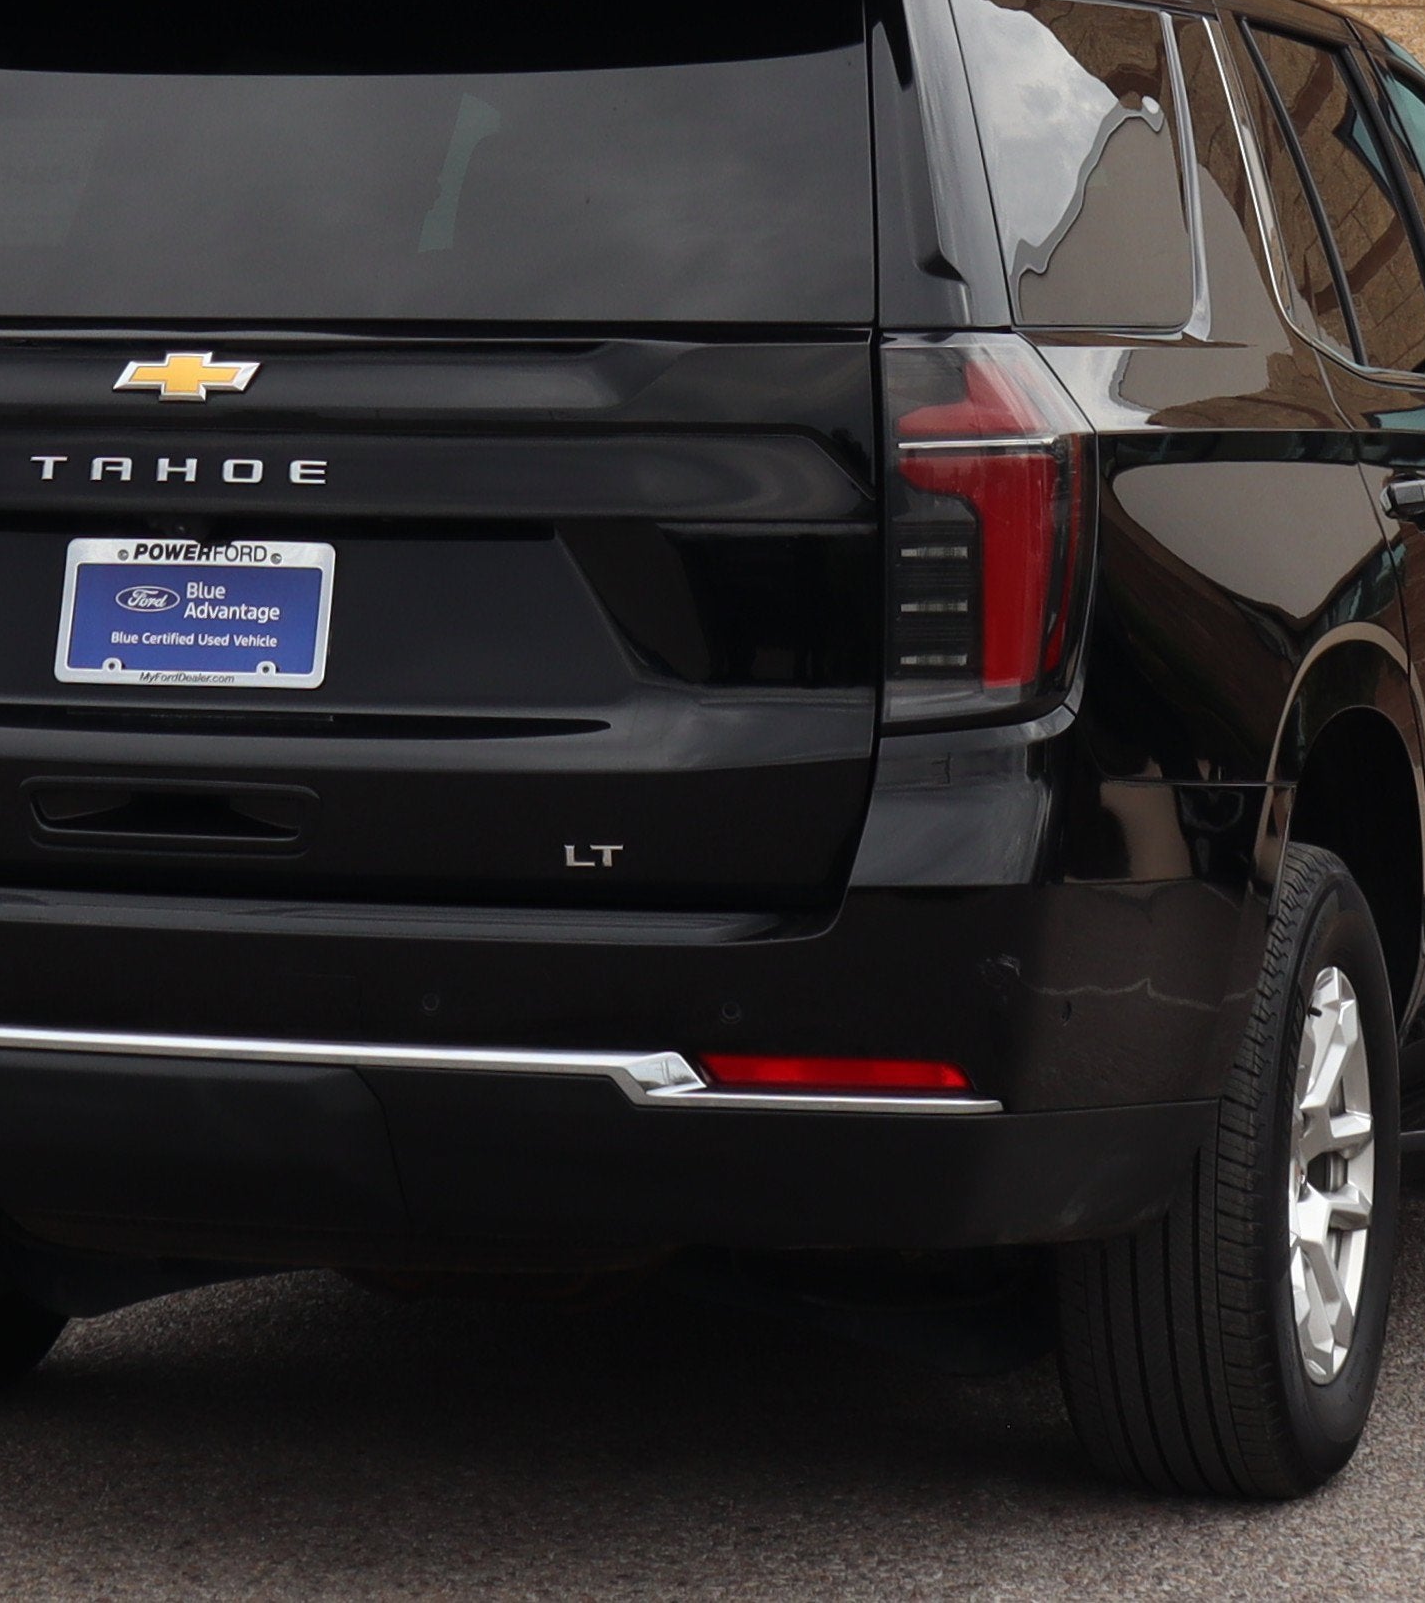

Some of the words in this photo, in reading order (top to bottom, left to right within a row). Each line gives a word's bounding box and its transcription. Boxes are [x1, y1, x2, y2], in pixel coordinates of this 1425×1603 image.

[30, 455, 328, 485] TAHOE
[127, 588, 169, 608] Ford
[186, 581, 226, 599] Blue
[183, 601, 281, 624] Advantage
[110, 631, 139, 644] Blue
[141, 632, 194, 646] Certified
[198, 633, 230, 646] Used
[233, 634, 278, 648] Vehicle
[138, 671, 235, 684] MyFordDealer.com
[563, 844, 624, 867] LT
